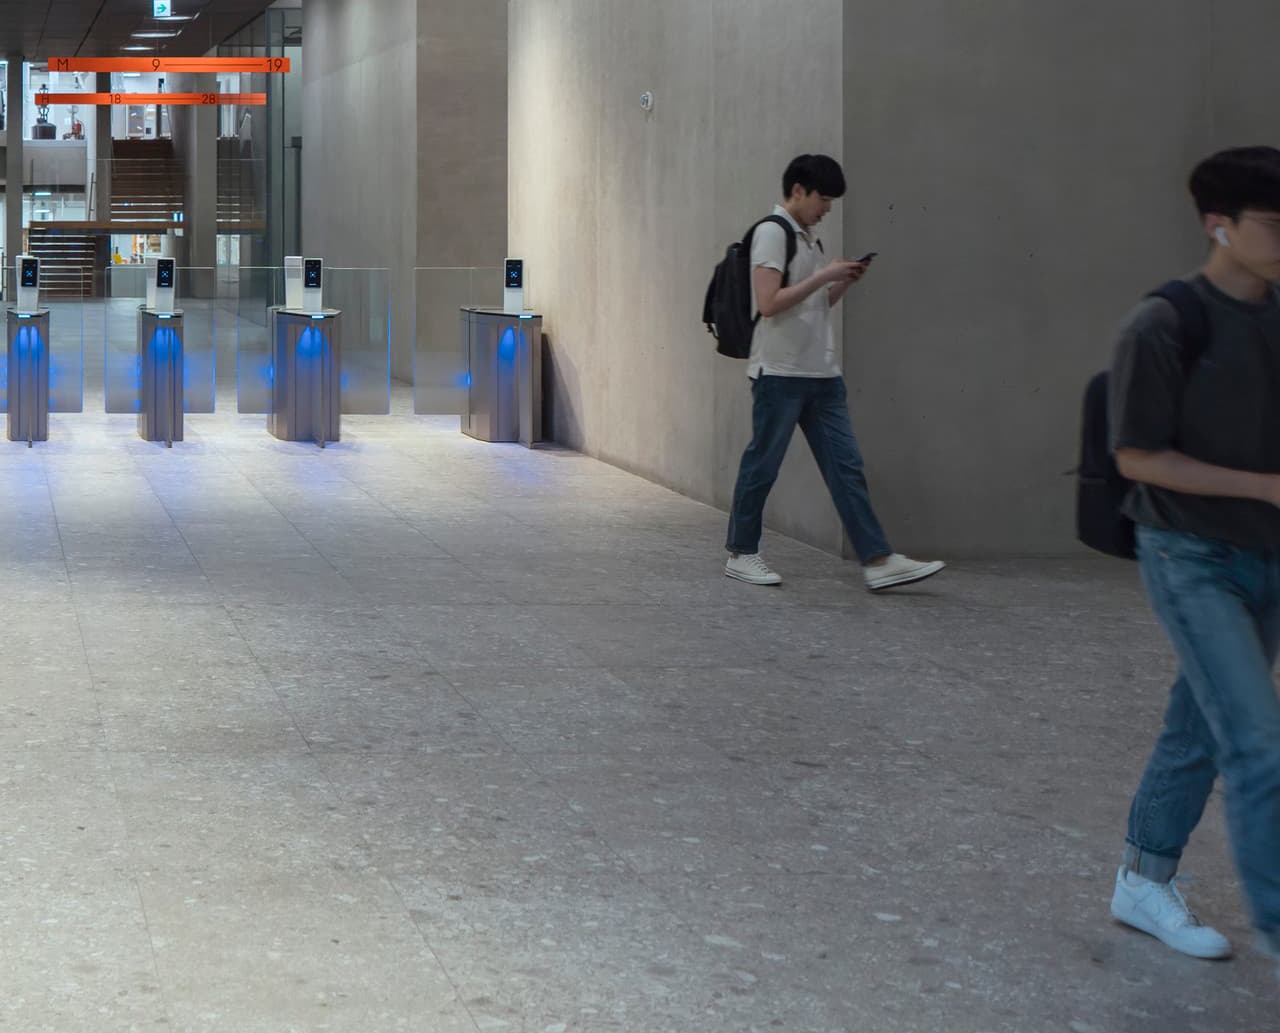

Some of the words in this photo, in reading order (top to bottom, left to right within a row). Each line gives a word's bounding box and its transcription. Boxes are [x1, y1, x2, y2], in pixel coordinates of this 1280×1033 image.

[57, 58, 69, 71] M
[152, 58, 160, 71] 9
[266, 58, 283, 71] 19
[109, 93, 122, 104] 18
[201, 93, 216, 105] 28
